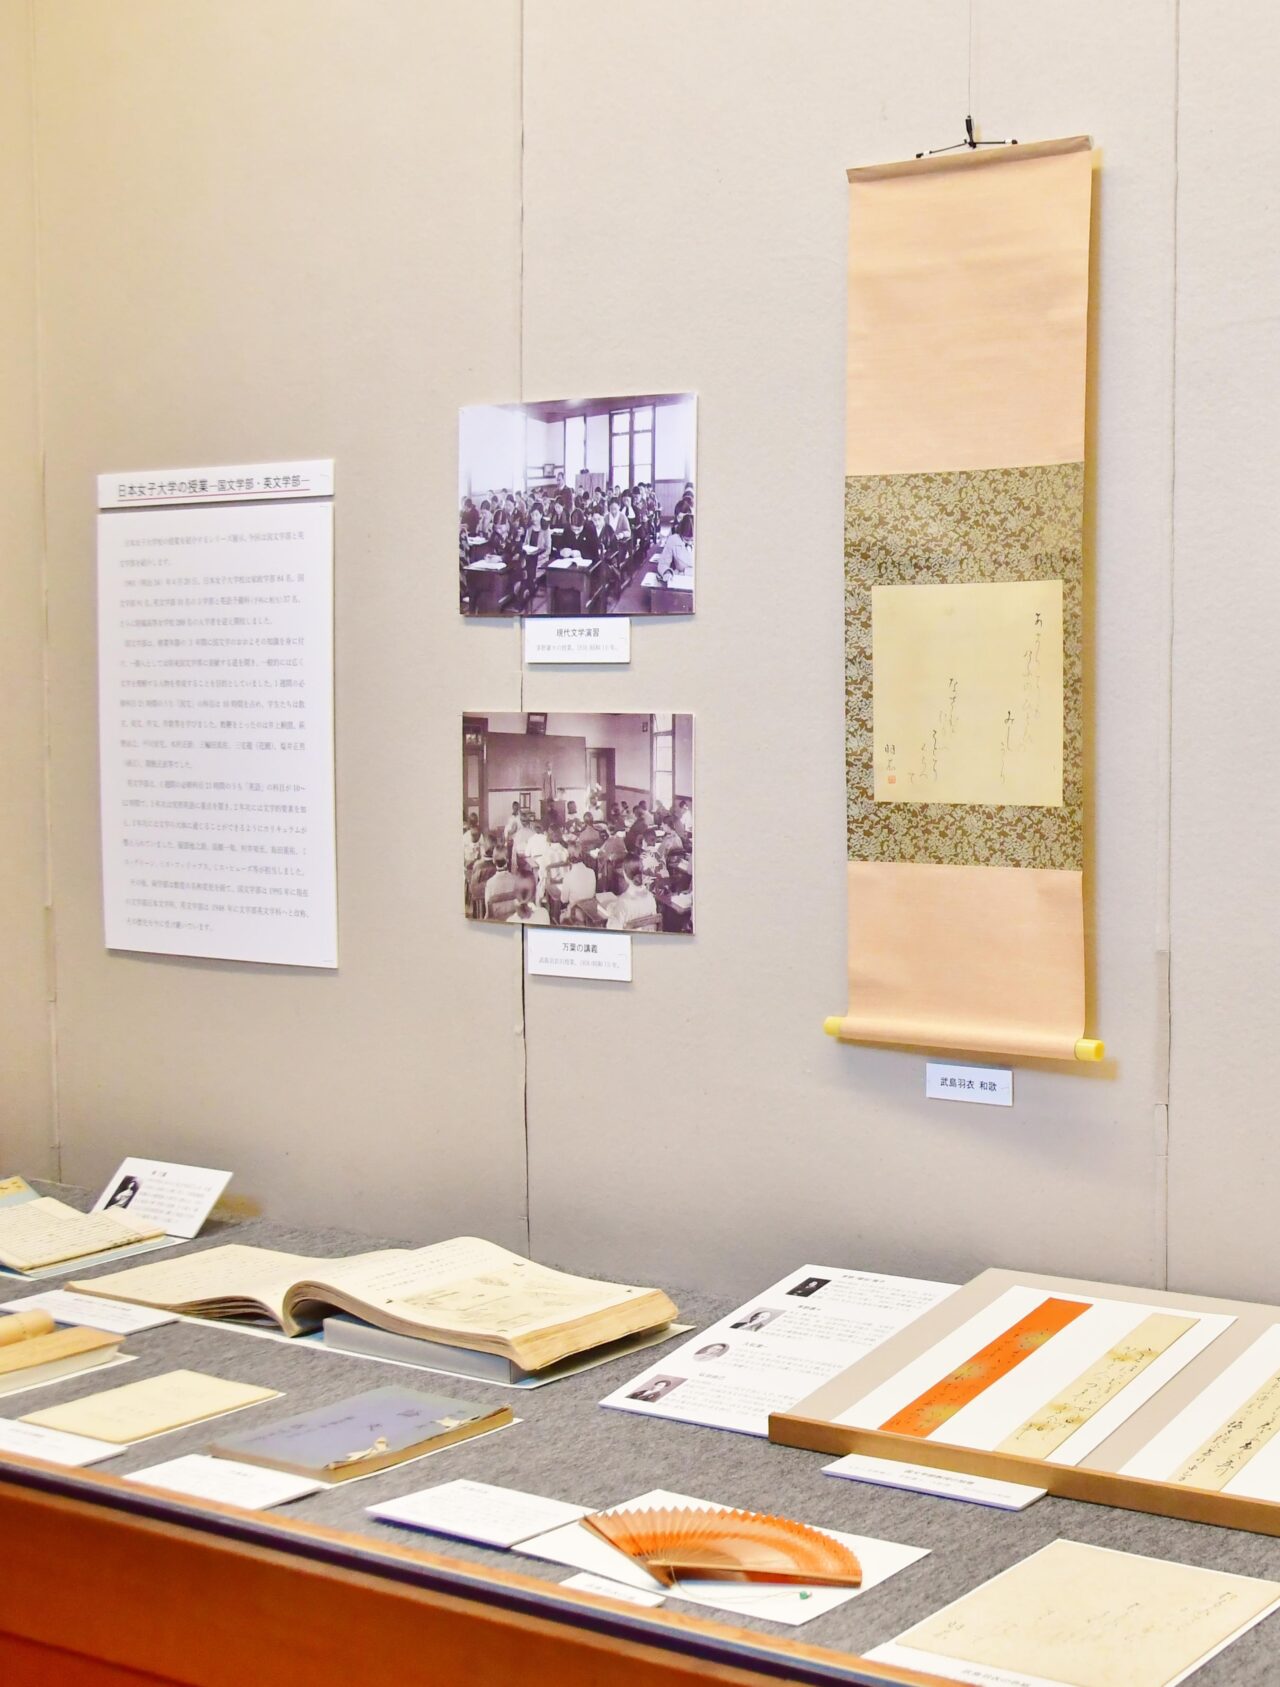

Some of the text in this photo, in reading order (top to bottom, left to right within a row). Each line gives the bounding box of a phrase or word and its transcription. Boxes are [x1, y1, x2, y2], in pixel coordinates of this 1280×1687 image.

[562, 942, 598, 954] 万葉の講義
[940, 1077, 998, 1092] 武島羽衣 和歌
